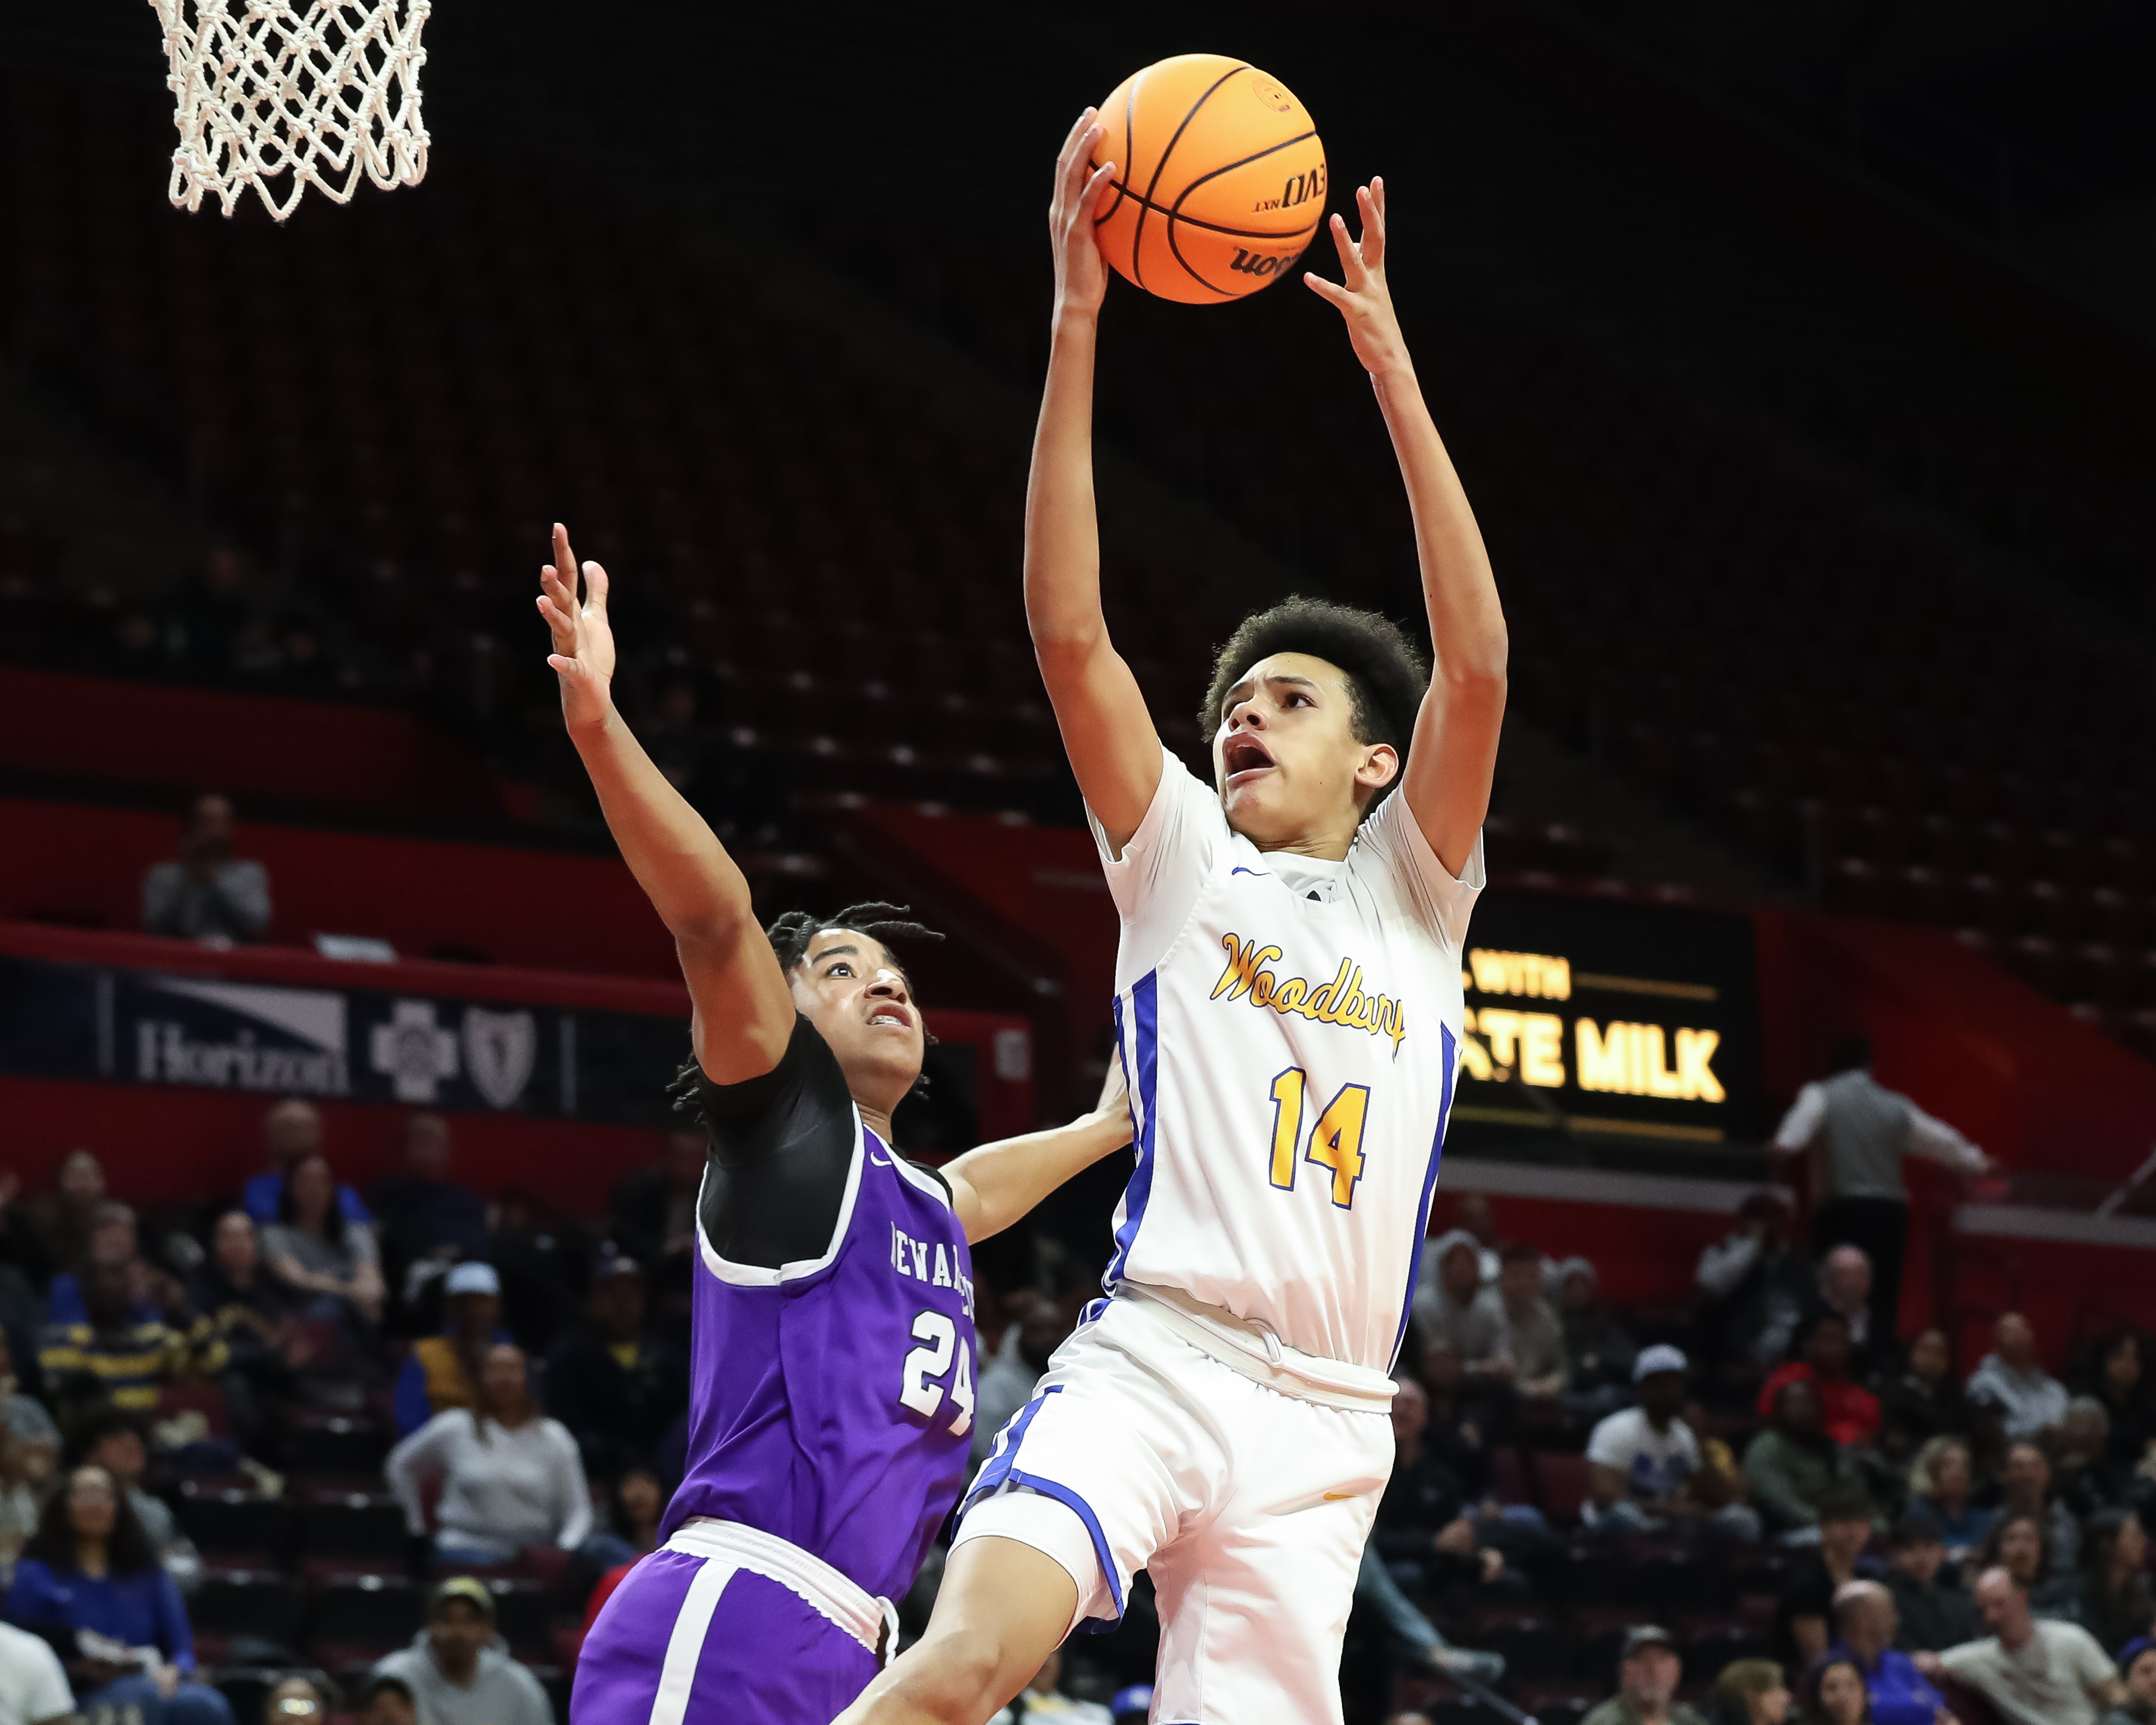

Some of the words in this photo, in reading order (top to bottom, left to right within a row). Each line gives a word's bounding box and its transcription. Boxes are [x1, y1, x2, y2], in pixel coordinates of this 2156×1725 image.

[1210, 932, 1406, 1064] Woodbury
[1469, 948, 1571, 1001] WITH
[136, 1018, 350, 1096] Horizon
[1576, 1017, 1727, 1104] MILK
[1269, 1066, 1370, 1210] 14
[900, 1309, 975, 1437] 24
